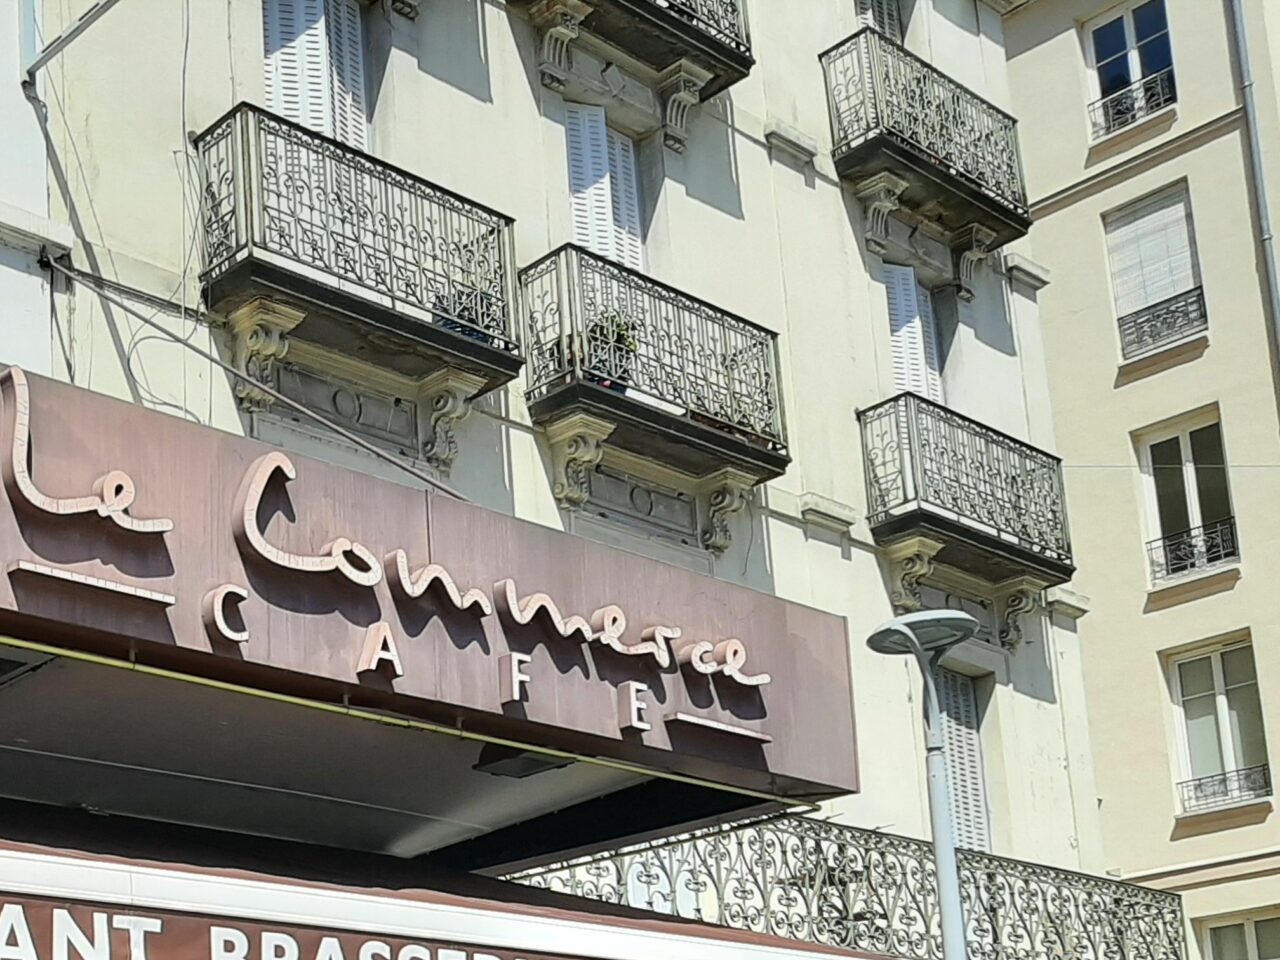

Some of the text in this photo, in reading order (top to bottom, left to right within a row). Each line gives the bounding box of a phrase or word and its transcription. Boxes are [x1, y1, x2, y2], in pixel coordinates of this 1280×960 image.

[0, 366, 773, 688] Le Commerce
[202, 583, 653, 738] CAFE
